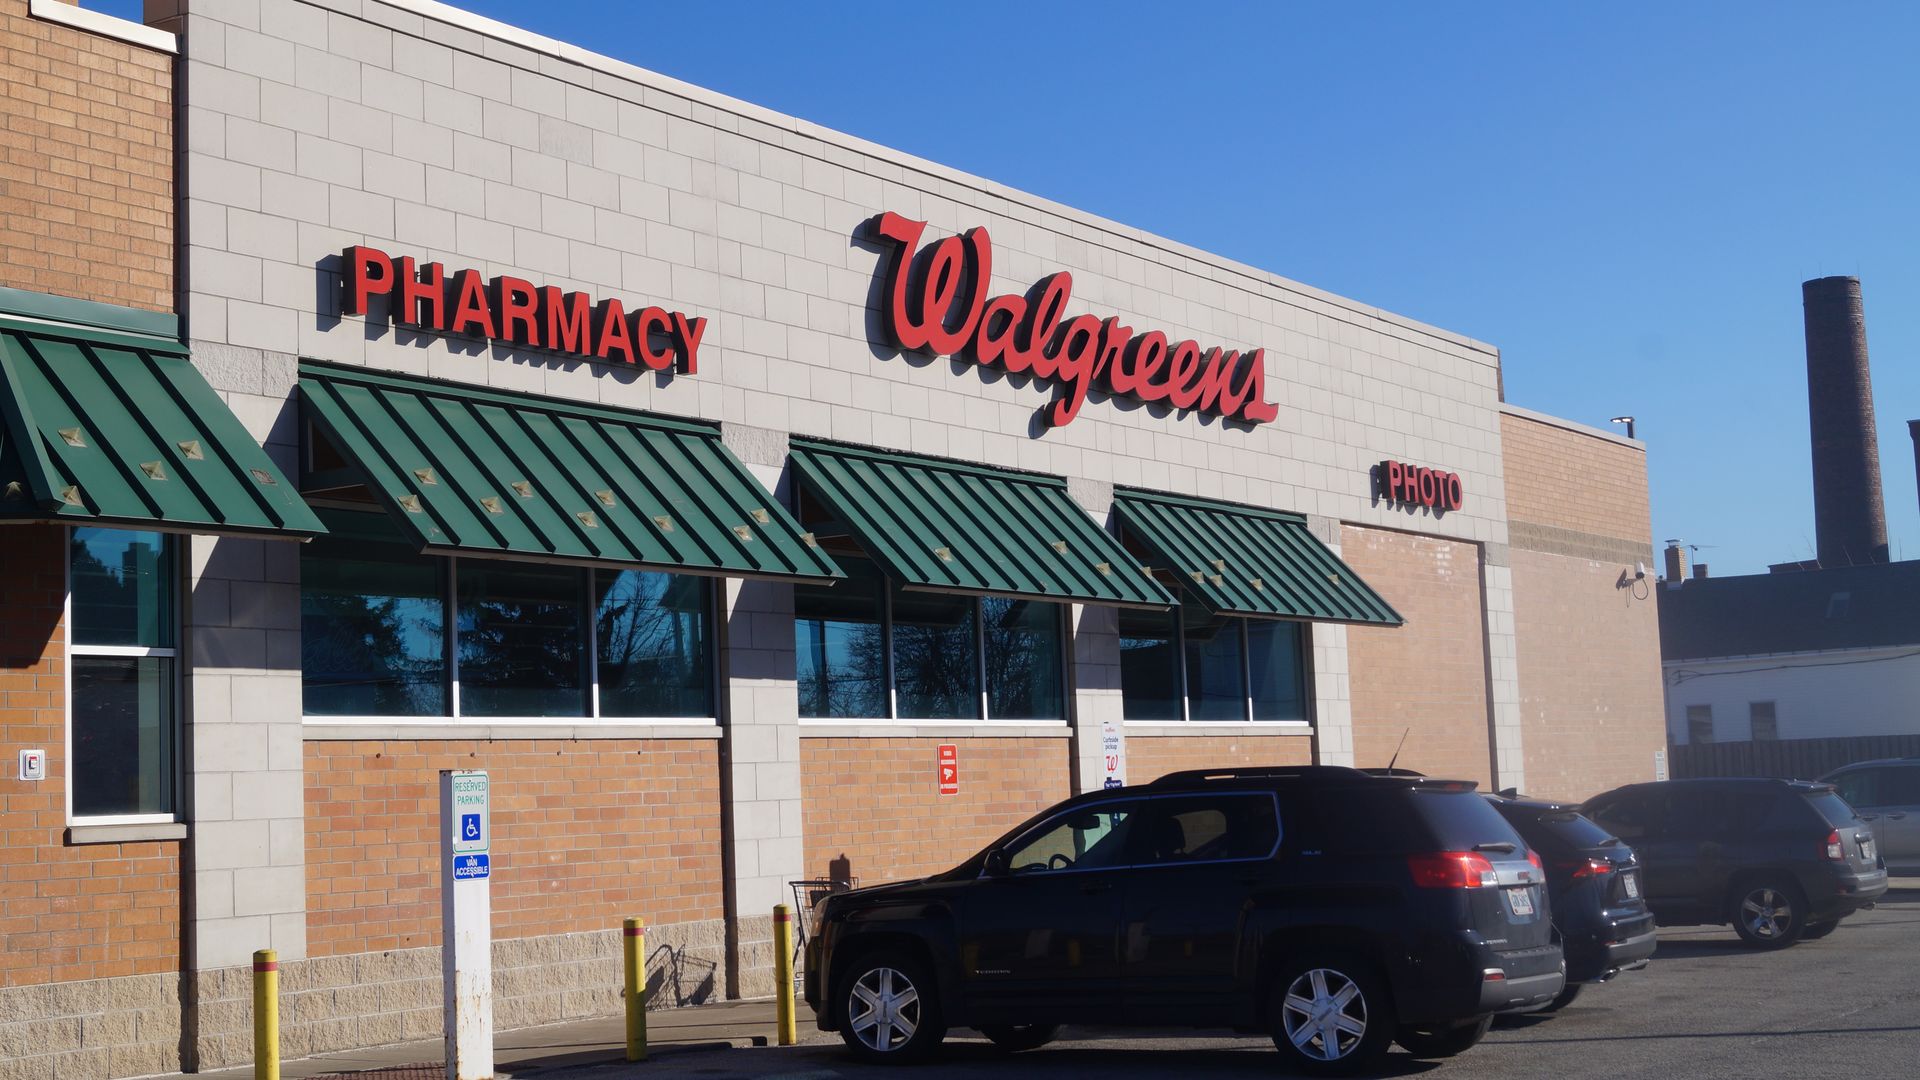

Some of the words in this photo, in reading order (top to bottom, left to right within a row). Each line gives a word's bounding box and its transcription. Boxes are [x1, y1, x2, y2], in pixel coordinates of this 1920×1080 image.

[349, 245, 708, 376] PHARMACY
[879, 211, 1279, 427] Walgreens
[1385, 460, 1463, 511] PHOTO
[455, 782, 487, 792] RESERVED
[457, 795, 485, 805] PARKING
[466, 858, 478, 867] VAN
[455, 866, 488, 877] ACCESSIBLE
